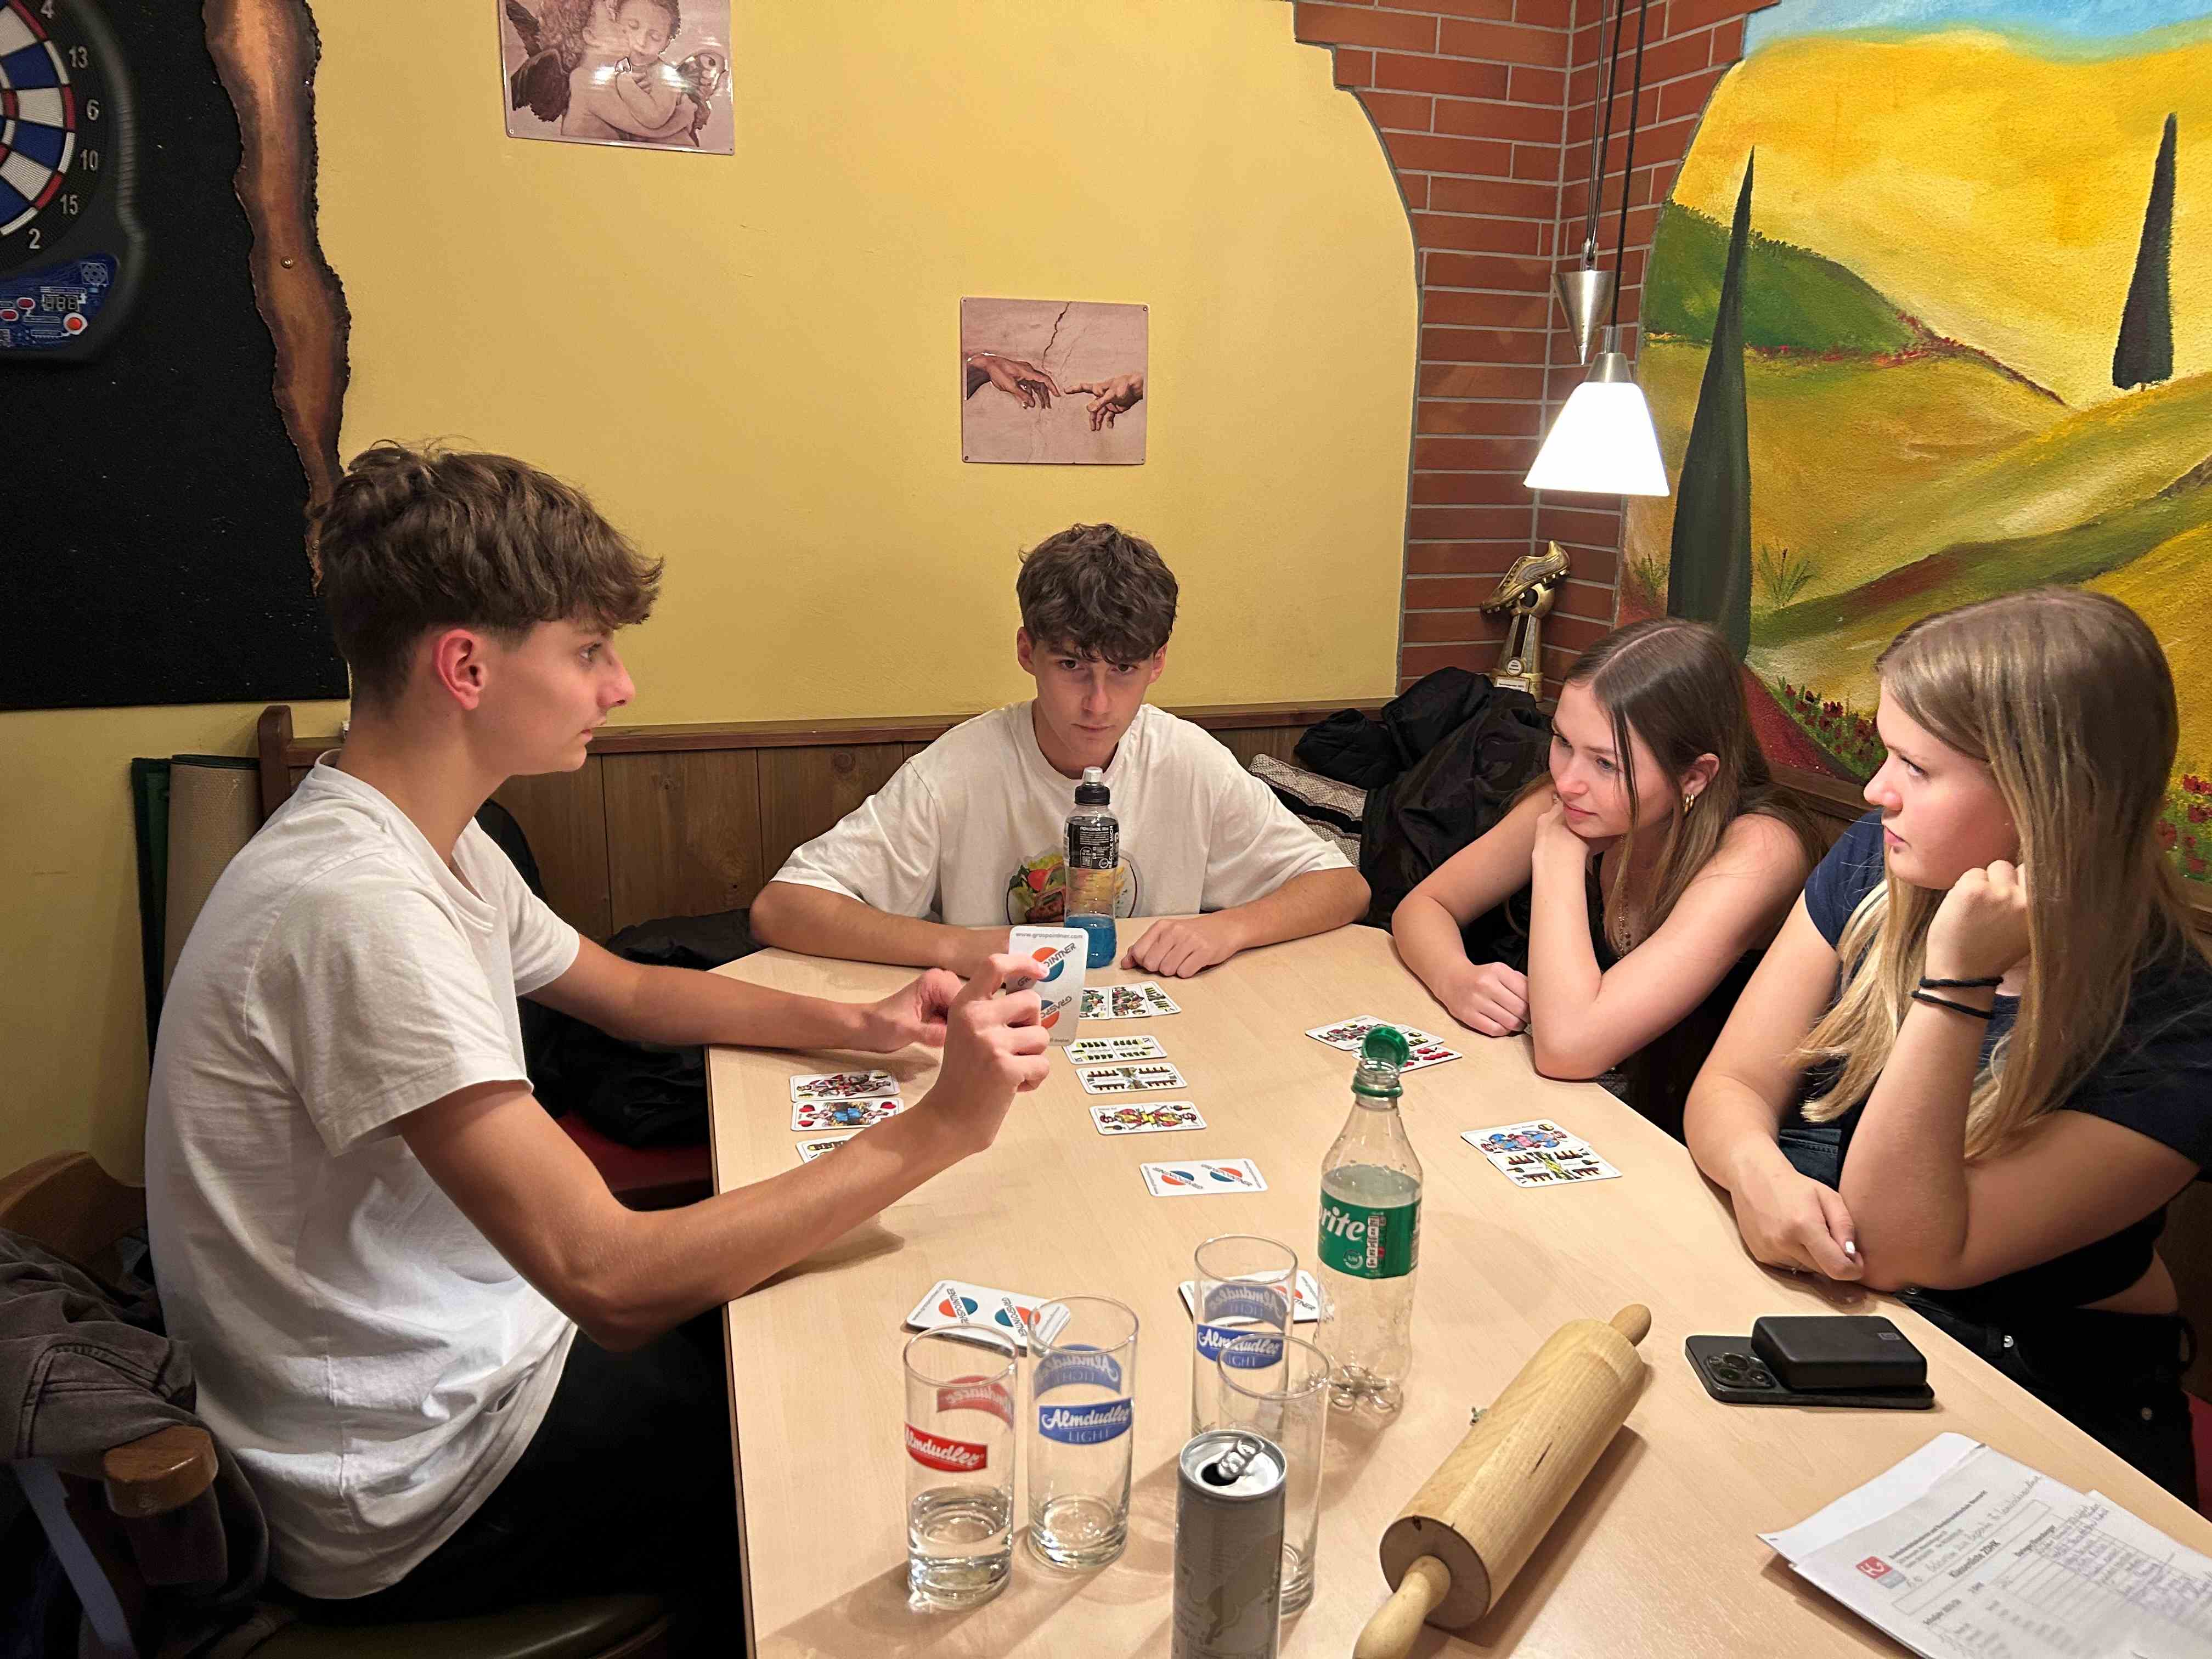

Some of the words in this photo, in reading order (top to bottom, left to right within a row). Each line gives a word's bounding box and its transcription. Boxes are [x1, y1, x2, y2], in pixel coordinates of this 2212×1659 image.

[41, 0, 54, 19] 4
[69, 46, 88, 68] 13
[87, 99, 99, 121] 6
[80, 150, 99, 171] 10
[60, 195, 78, 215] 15
[29, 229, 40, 249] 2
[1319, 1206, 1365, 1242] rite
[1041, 1404, 1130, 1431] Almdudler
[1069, 1428, 1108, 1442] LIGHT
